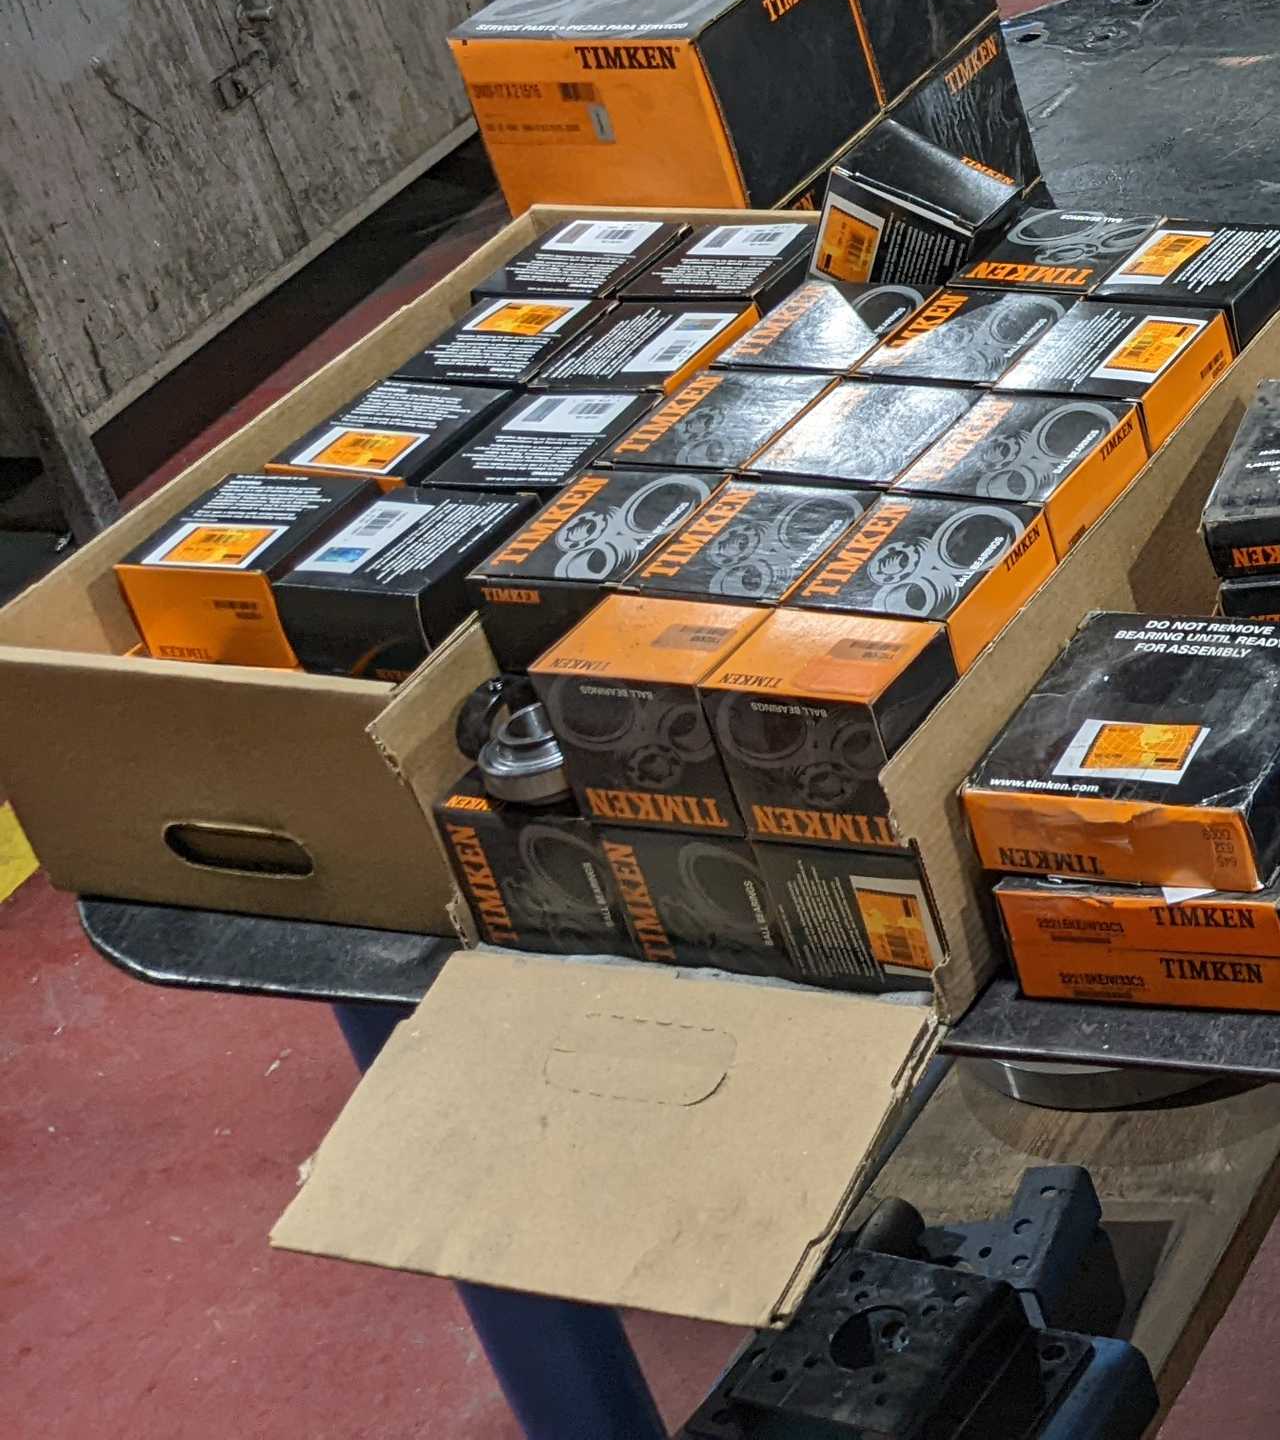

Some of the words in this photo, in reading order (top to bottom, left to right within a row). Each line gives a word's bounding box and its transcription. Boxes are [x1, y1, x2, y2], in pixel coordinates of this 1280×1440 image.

[475, 22, 520, 32] SERVICE
[523, 22, 558, 32] PARTS
[566, 22, 604, 32] PIEZAS
[607, 22, 635, 32] PARA
[637, 22, 688, 32] SERVICIO
[574, 46, 681, 71] TIMKEN
[943, 34, 998, 97] TIMKEN
[959, 155, 1017, 187] TIMKEN
[967, 260, 1097, 287] TIMKEN
[615, 372, 726, 454] TIMKEN
[1100, 418, 1134, 463] TIMKEN
[490, 472, 611, 567] TIMKEN
[640, 488, 757, 579] TIMKEN
[802, 502, 912, 598] TIMKEN
[972, 534, 1005, 568] BEARINGS
[1002, 522, 1042, 574] TIMKEN
[481, 586, 541, 604] TIMKEN
[1114, 630, 1185, 643] BEARING
[1187, 633, 1233, 645] UNTIL
[1145, 619, 1172, 631] DO
[1173, 621, 1208, 633] NOT
[1208, 623, 1275, 636] REMOVE
[1133, 642, 1167, 654] FOR
[1167, 643, 1251, 659] ASSEMBLY
[549, 658, 611, 673] TIMKEN
[579, 685, 626, 697] BEARINGS
[627, 688, 654, 700] BALL
[718, 673, 783, 689] TIMKEN
[750, 701, 799, 716] BEARINGS
[801, 704, 828, 718] BALL
[988, 776, 1100, 794] www.timken.com
[585, 787, 730, 829] TIMKEN
[754, 804, 904, 848] TIMKEN
[998, 846, 1105, 876] TIMKEN
[447, 823, 519, 944] TIMKEN
[603, 840, 677, 962] TIMKEN
[743, 879, 771, 926] BEARINGS
[1149, 905, 1256, 929] TIMKEN
[1160, 958, 1265, 984] TIMKEN
